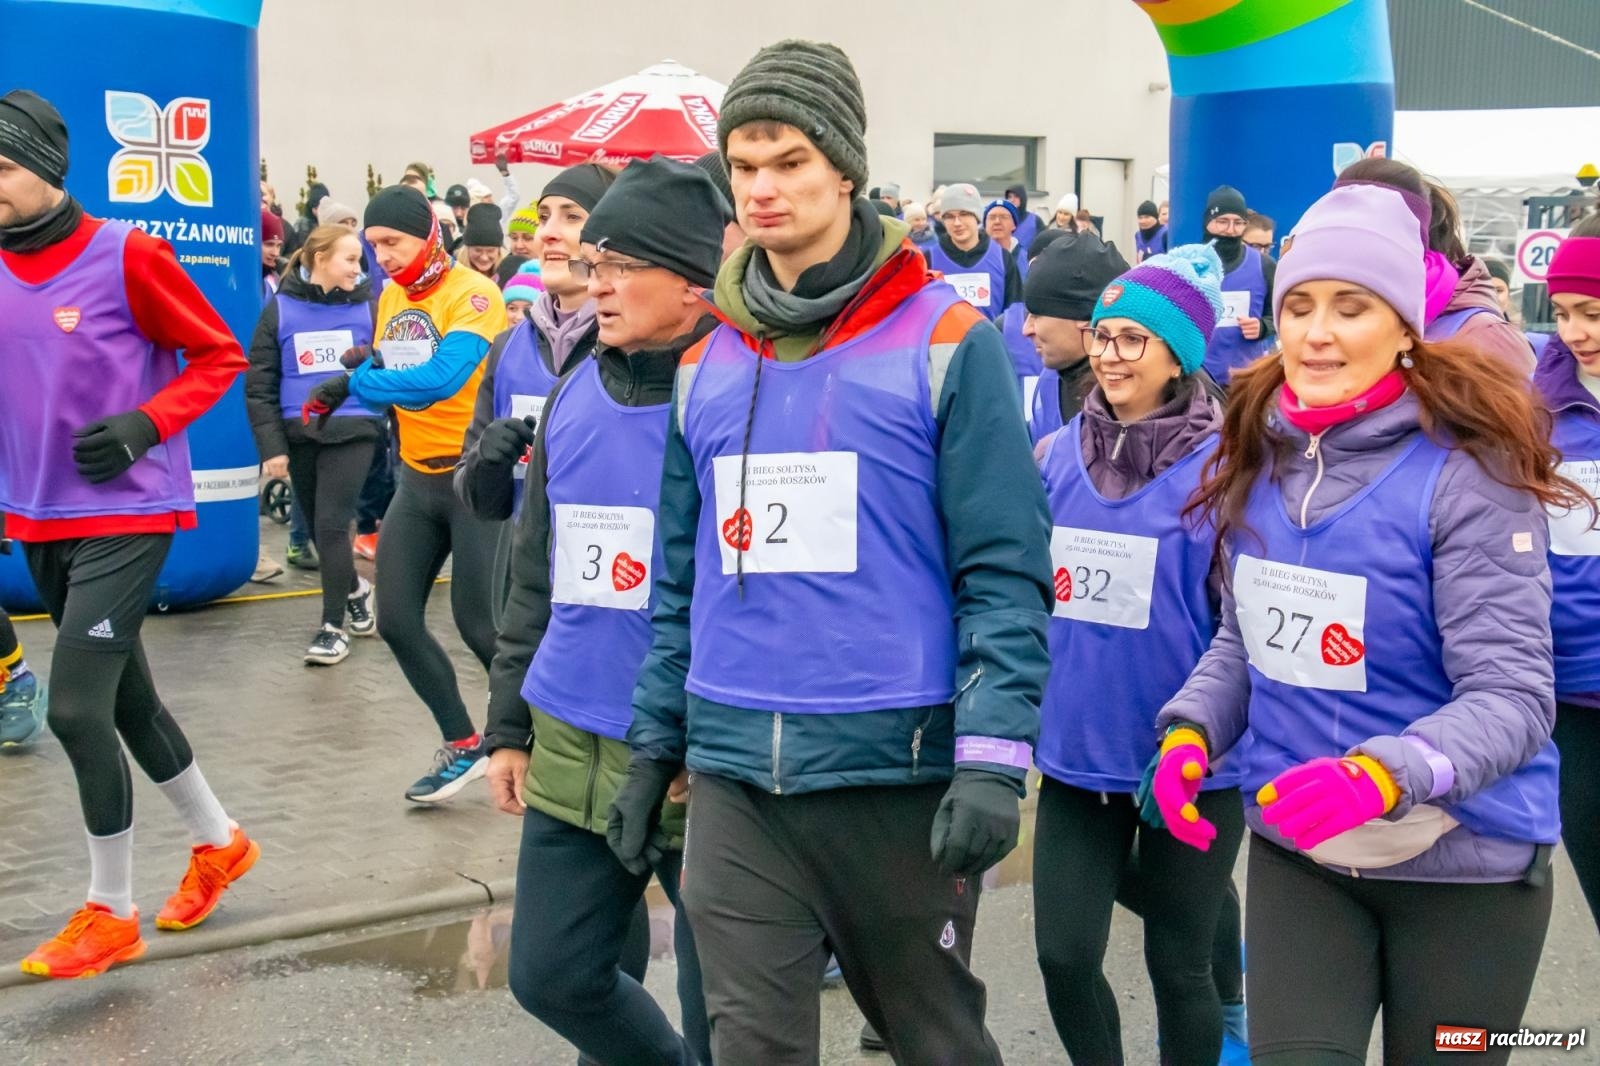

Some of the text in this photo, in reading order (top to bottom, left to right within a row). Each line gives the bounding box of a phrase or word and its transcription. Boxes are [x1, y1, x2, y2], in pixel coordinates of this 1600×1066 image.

[580, 94, 639, 138] WARKA
[179, 254, 231, 267] zapamiętaj
[1531, 246, 1557, 266] 20
[959, 285, 976, 299] 35
[314, 347, 336, 364] 58
[752, 466, 775, 475] BIEG
[775, 464, 817, 474] SOŁTYSA
[780, 475, 827, 485] ROSZKÓW
[579, 511, 597, 520] BIEG
[765, 502, 788, 544] 2
[582, 544, 603, 581] 3
[1073, 565, 1111, 603] 32
[1261, 566, 1329, 589] II BIEG SOŁTYSA
[1292, 585, 1337, 601] ROSZKÓW
[1266, 606, 1314, 654] 27
